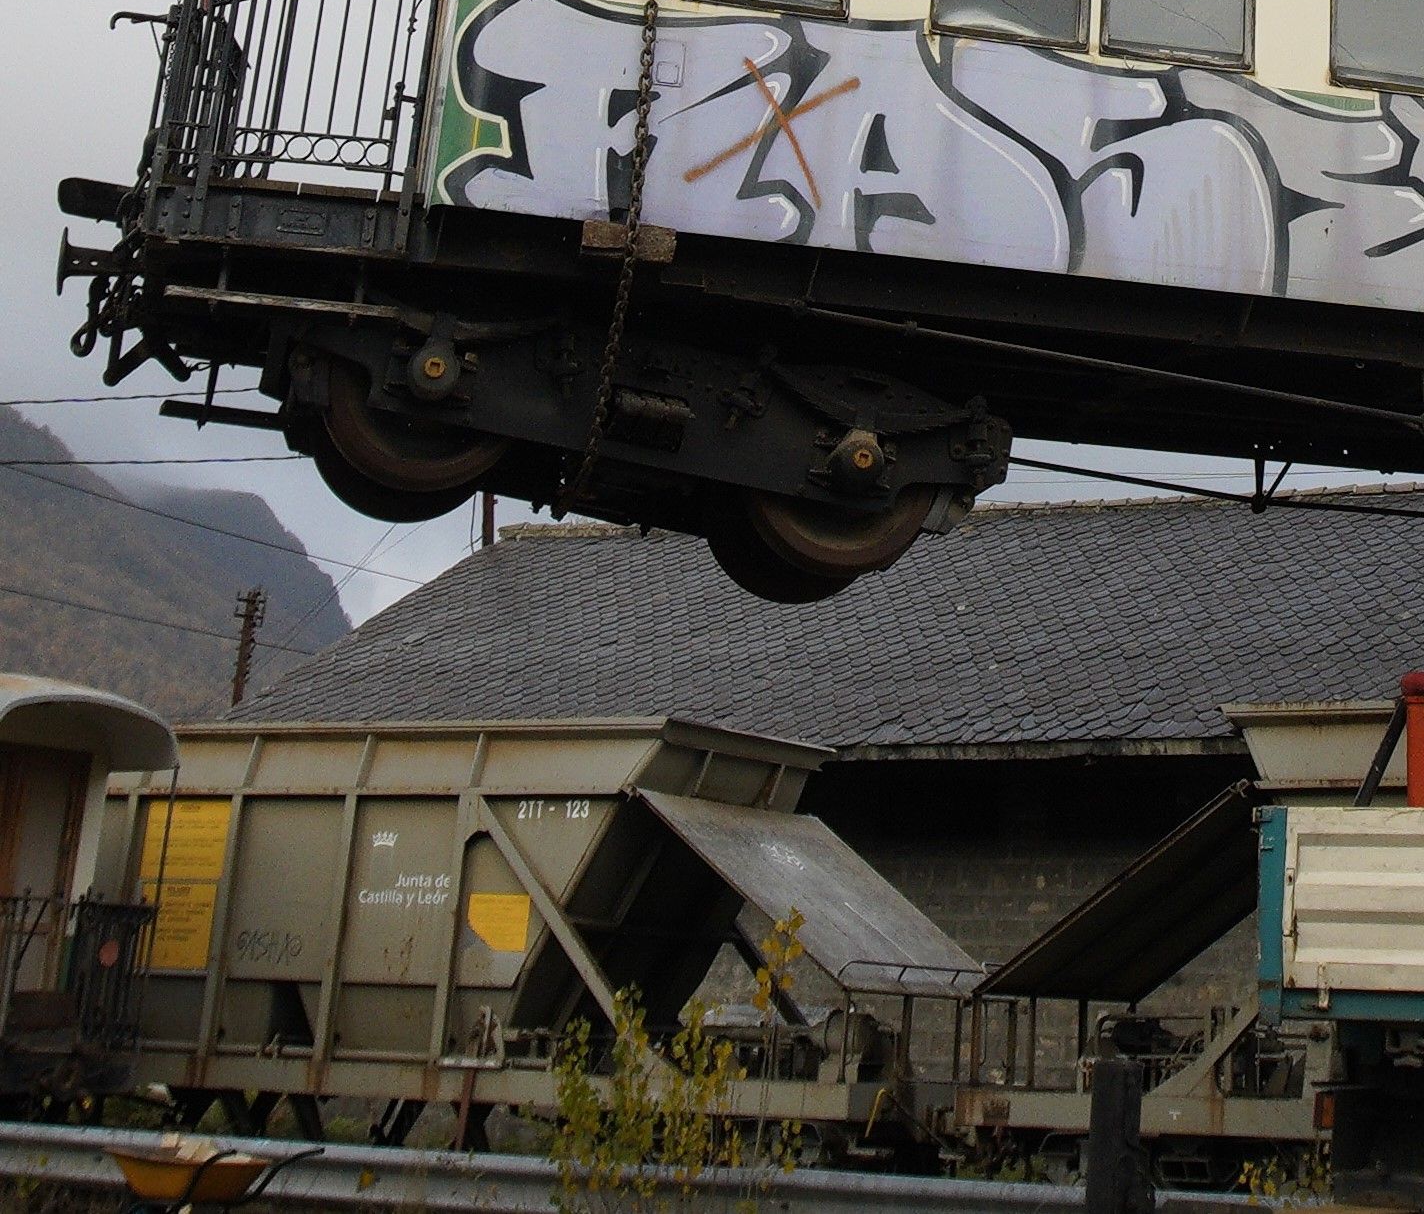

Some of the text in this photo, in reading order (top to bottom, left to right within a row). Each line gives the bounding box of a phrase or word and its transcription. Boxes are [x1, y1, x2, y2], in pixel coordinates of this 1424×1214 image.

[566, 799, 589, 819] 123
[395, 872, 451, 888] Junta de
[359, 889, 402, 904] Castilla
[405, 892, 414, 908] y
